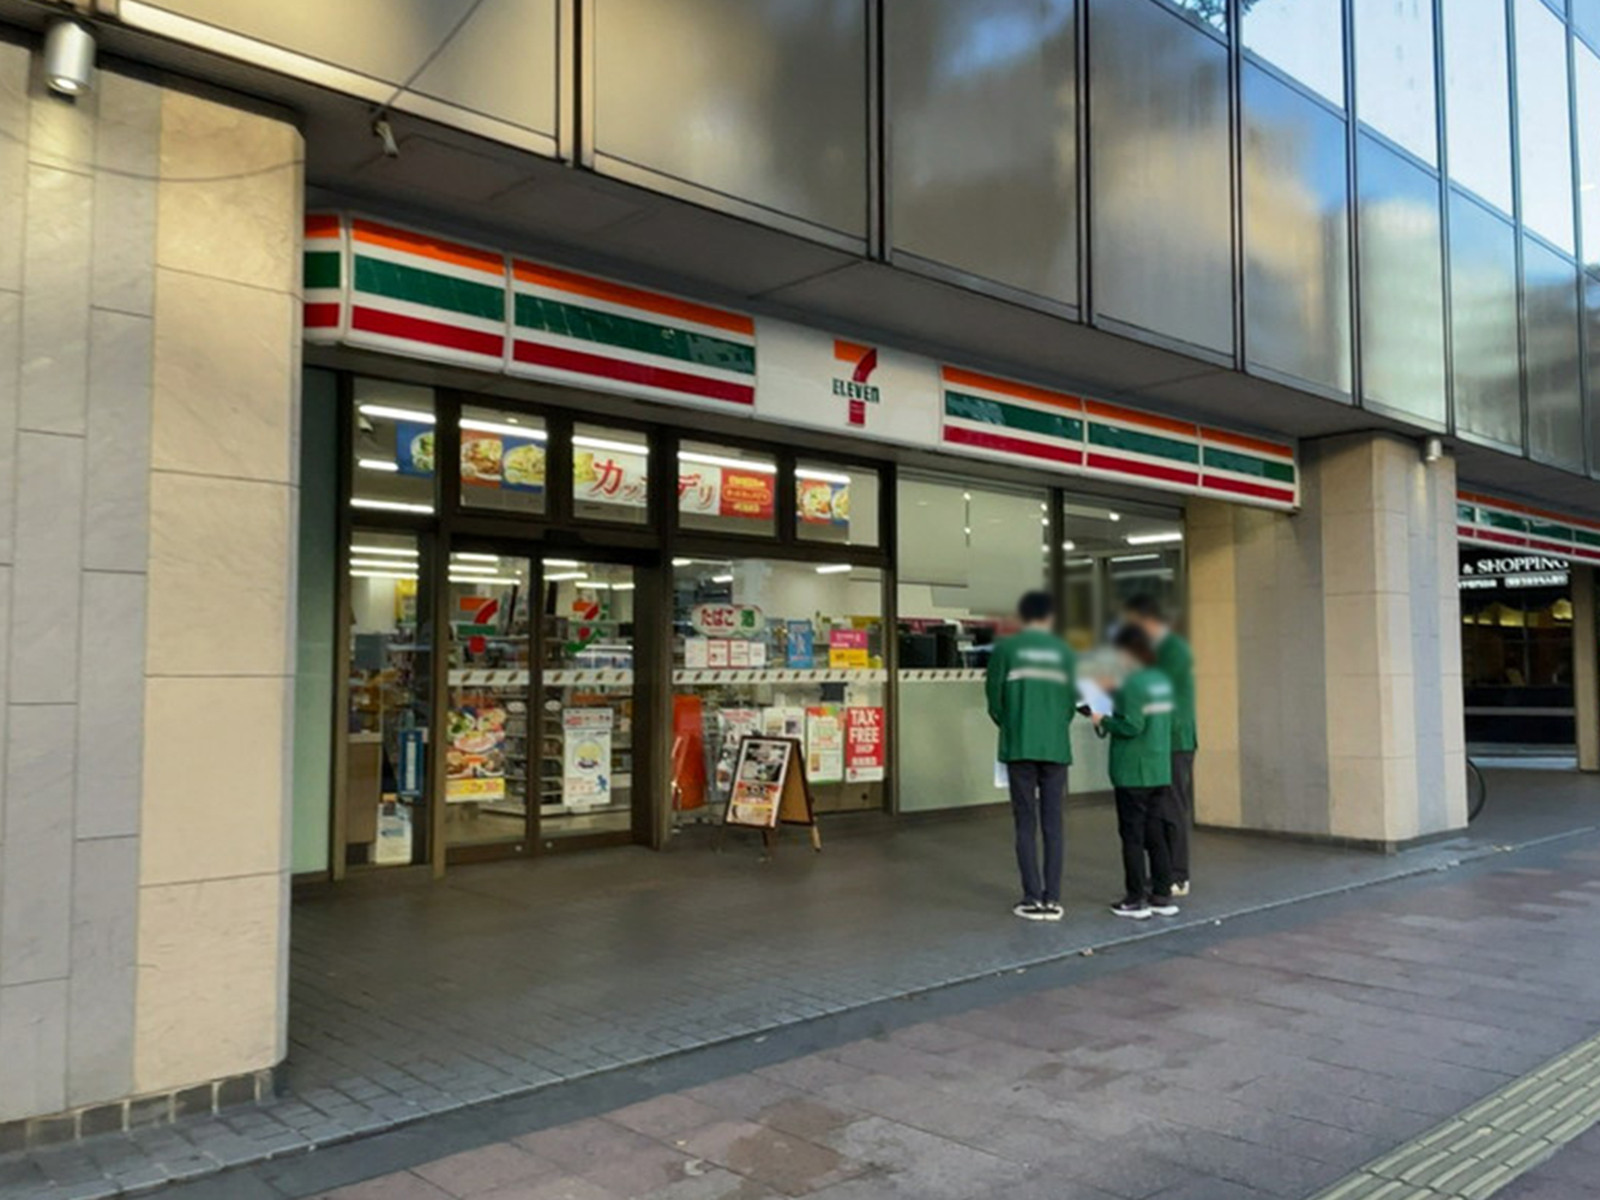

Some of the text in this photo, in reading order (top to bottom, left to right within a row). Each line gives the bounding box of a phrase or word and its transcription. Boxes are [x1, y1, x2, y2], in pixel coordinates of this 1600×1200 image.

[1477, 556, 1569, 574] SHOPPING
[701, 608, 735, 627] たばこ
[849, 727, 880, 744] FREE
